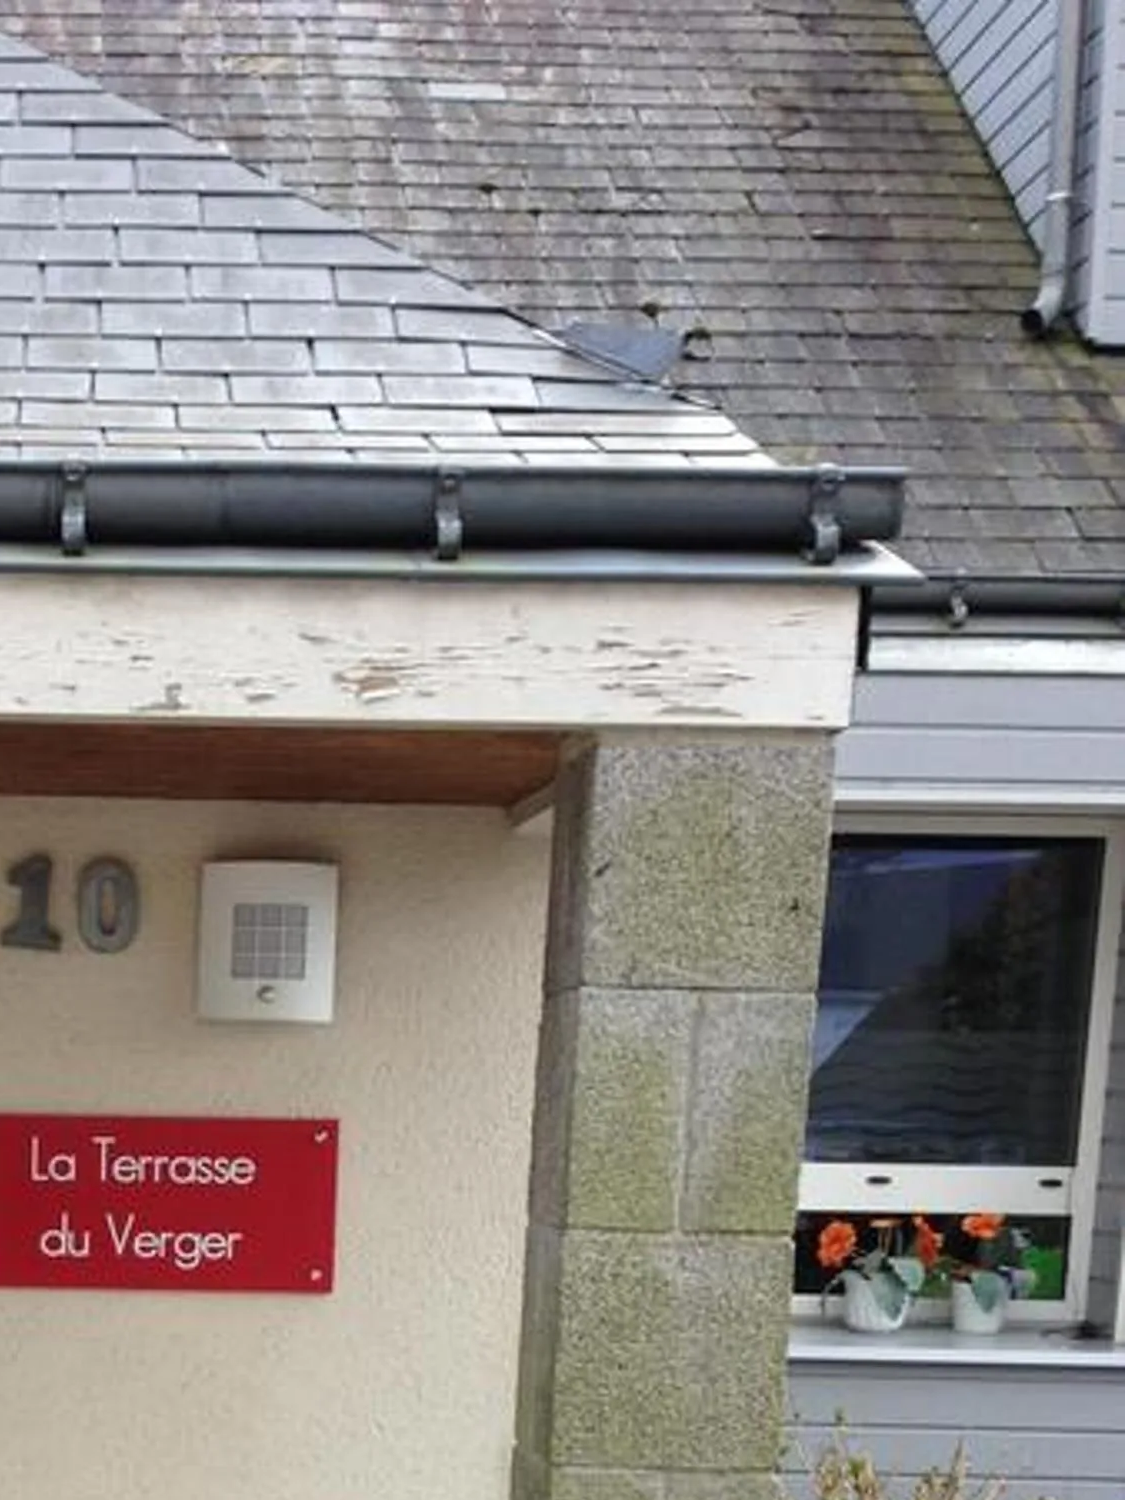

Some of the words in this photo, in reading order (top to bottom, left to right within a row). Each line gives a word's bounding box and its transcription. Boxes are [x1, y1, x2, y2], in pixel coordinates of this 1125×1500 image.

[0, 853, 141, 954] 10
[29, 1136, 75, 1182] La
[92, 1135, 257, 1185] Terrasse
[39, 1211, 90, 1257] du
[105, 1212, 243, 1270] Verger
